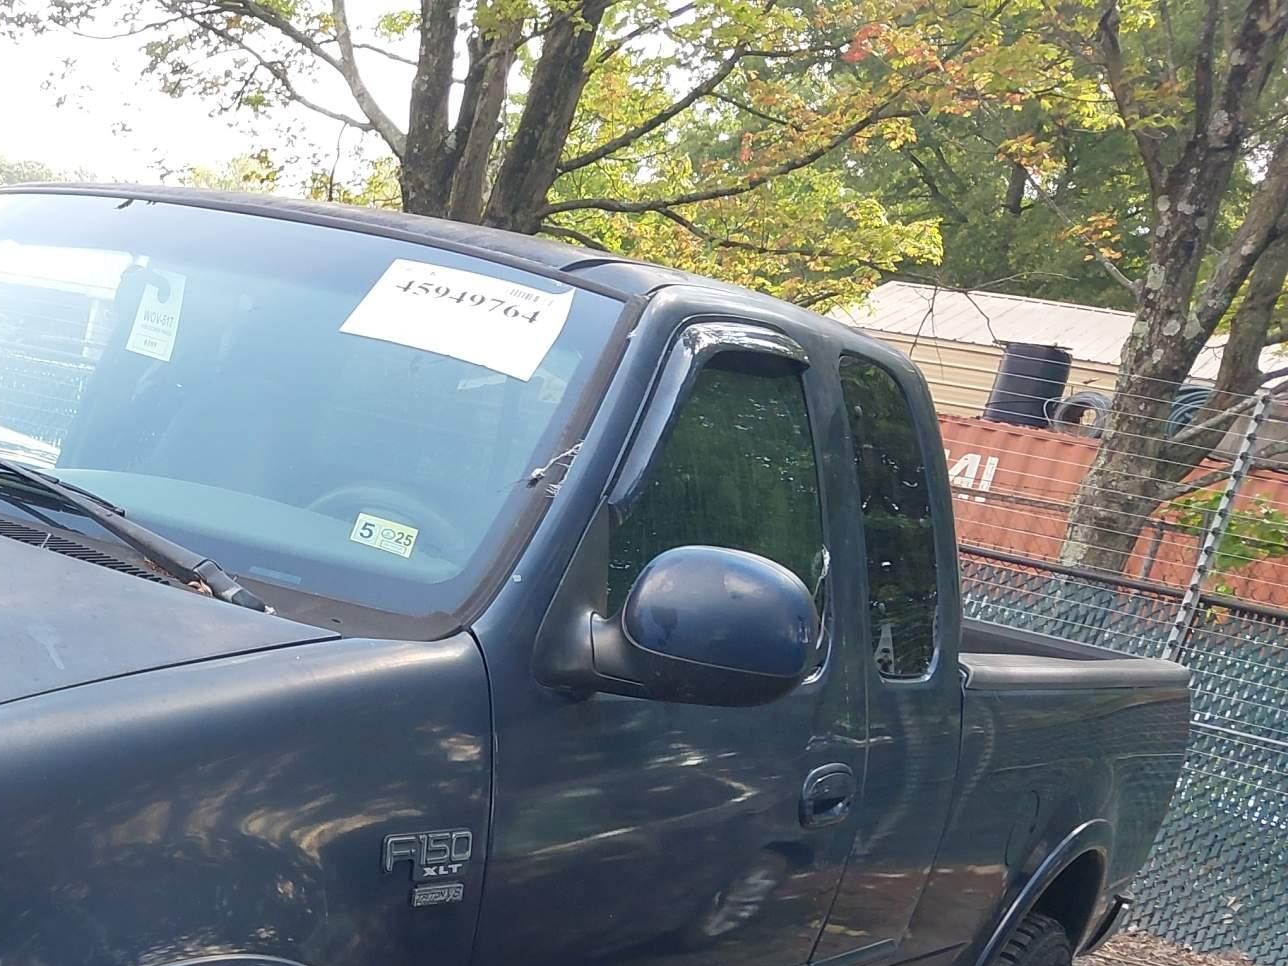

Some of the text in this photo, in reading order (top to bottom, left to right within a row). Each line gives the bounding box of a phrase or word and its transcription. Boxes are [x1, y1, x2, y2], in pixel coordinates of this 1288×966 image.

[396, 280, 541, 324] 45949764
[359, 522, 376, 539] 5
[394, 531, 414, 547] 25
[423, 864, 463, 877] XLT
